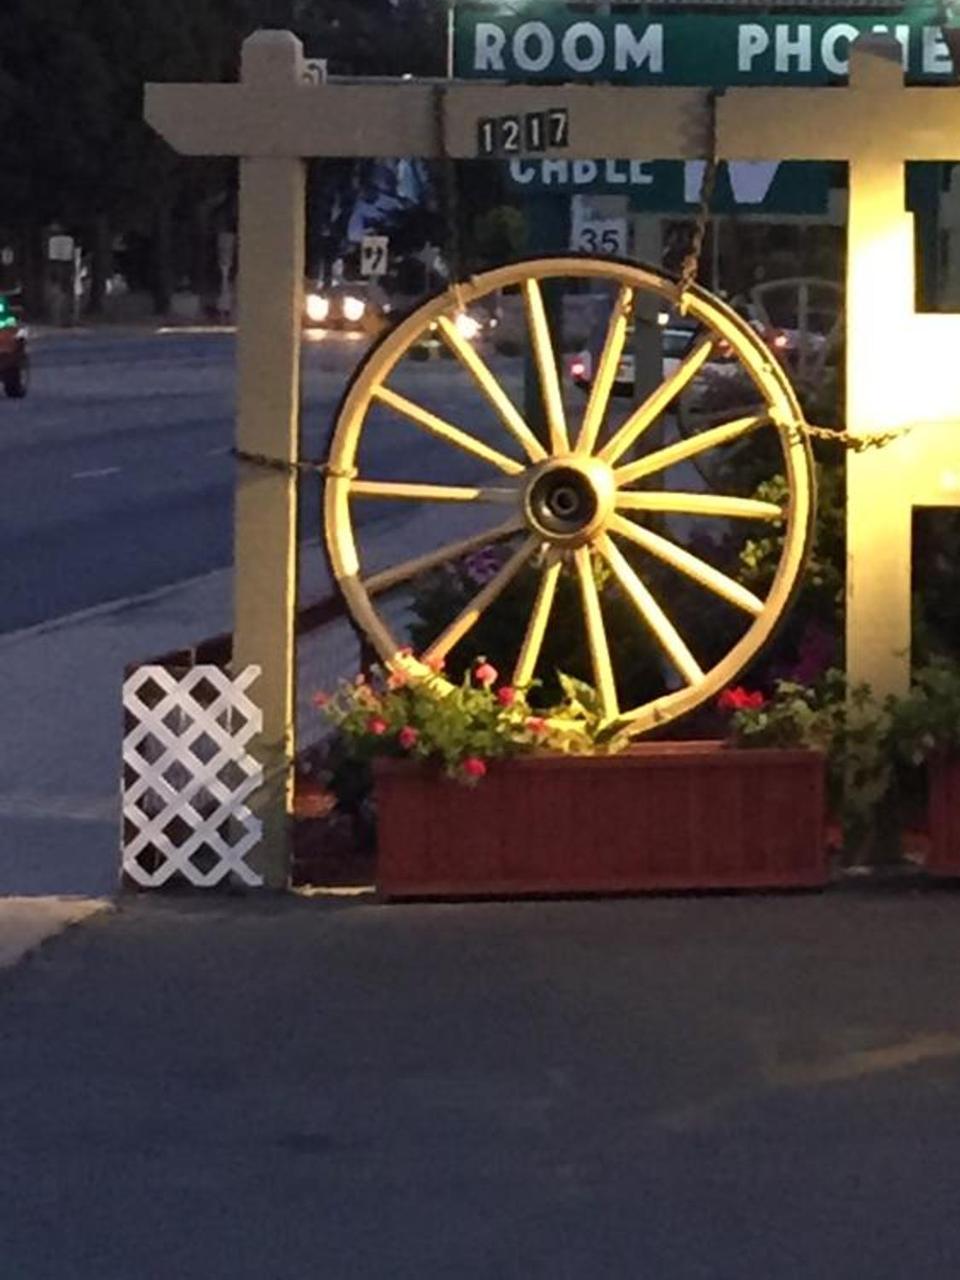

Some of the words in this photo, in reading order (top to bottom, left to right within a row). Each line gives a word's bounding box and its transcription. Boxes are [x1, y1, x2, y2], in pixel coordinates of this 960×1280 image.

[474, 21, 664, 73] ROOM
[481, 112, 568, 153] 1217
[579, 227, 620, 253] 35
